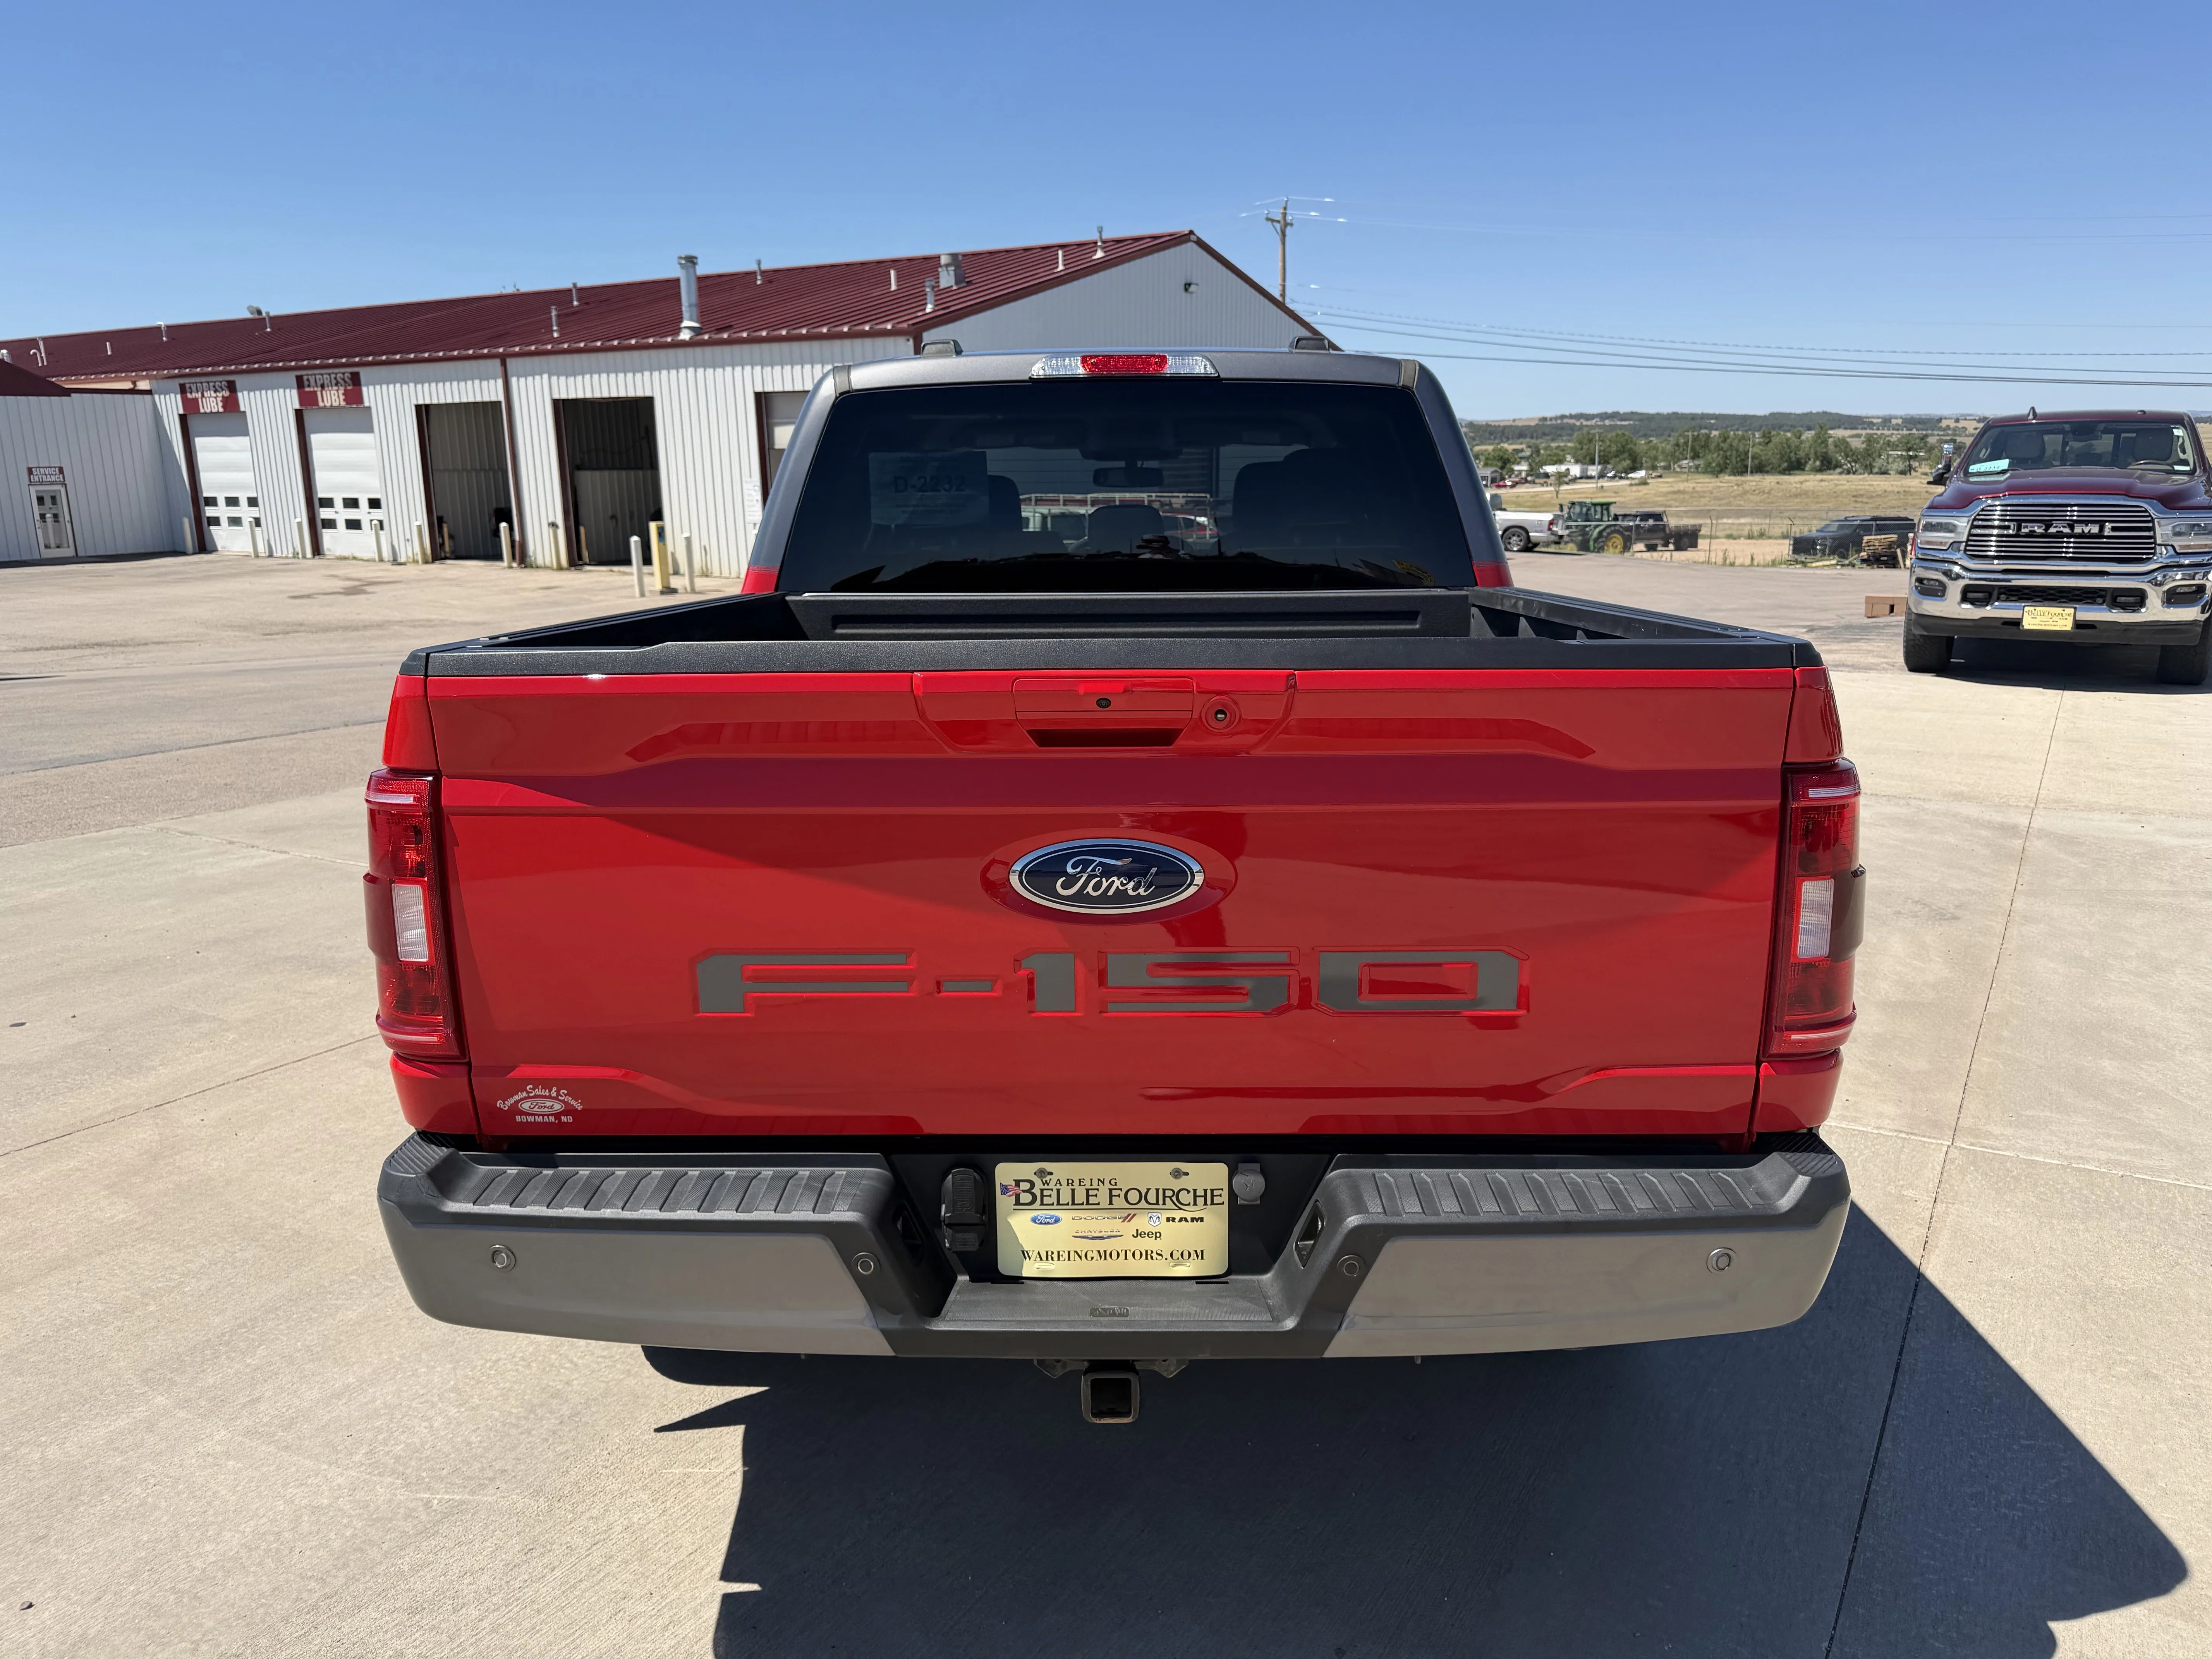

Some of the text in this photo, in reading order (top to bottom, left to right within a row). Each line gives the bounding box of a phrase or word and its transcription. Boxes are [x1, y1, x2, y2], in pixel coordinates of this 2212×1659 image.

[185, 381, 230, 398] EXPRESS
[303, 372, 353, 391] EXPRESS
[198, 397, 224, 413] LUBE
[317, 390, 346, 407] LUBE
[30, 474, 64, 482] ENTRANCE
[894, 475, 966, 493] D-2232
[2021, 522, 2100, 533] RAM
[1056, 856, 1158, 896] Ford
[696, 948, 1528, 1016] F-150
[496, 1085, 583, 1110] Bowman Sales & Service
[528, 1101, 555, 1110] Ford
[1041, 1178, 1118, 1187] WAREING
[1013, 1179, 1224, 1212] BELLE FOURCHE
[1036, 1214, 1055, 1224] Ford
[1132, 1229, 1162, 1240] Jeep
[1020, 1249, 1206, 1261] WAREINGMOTORS.COM
